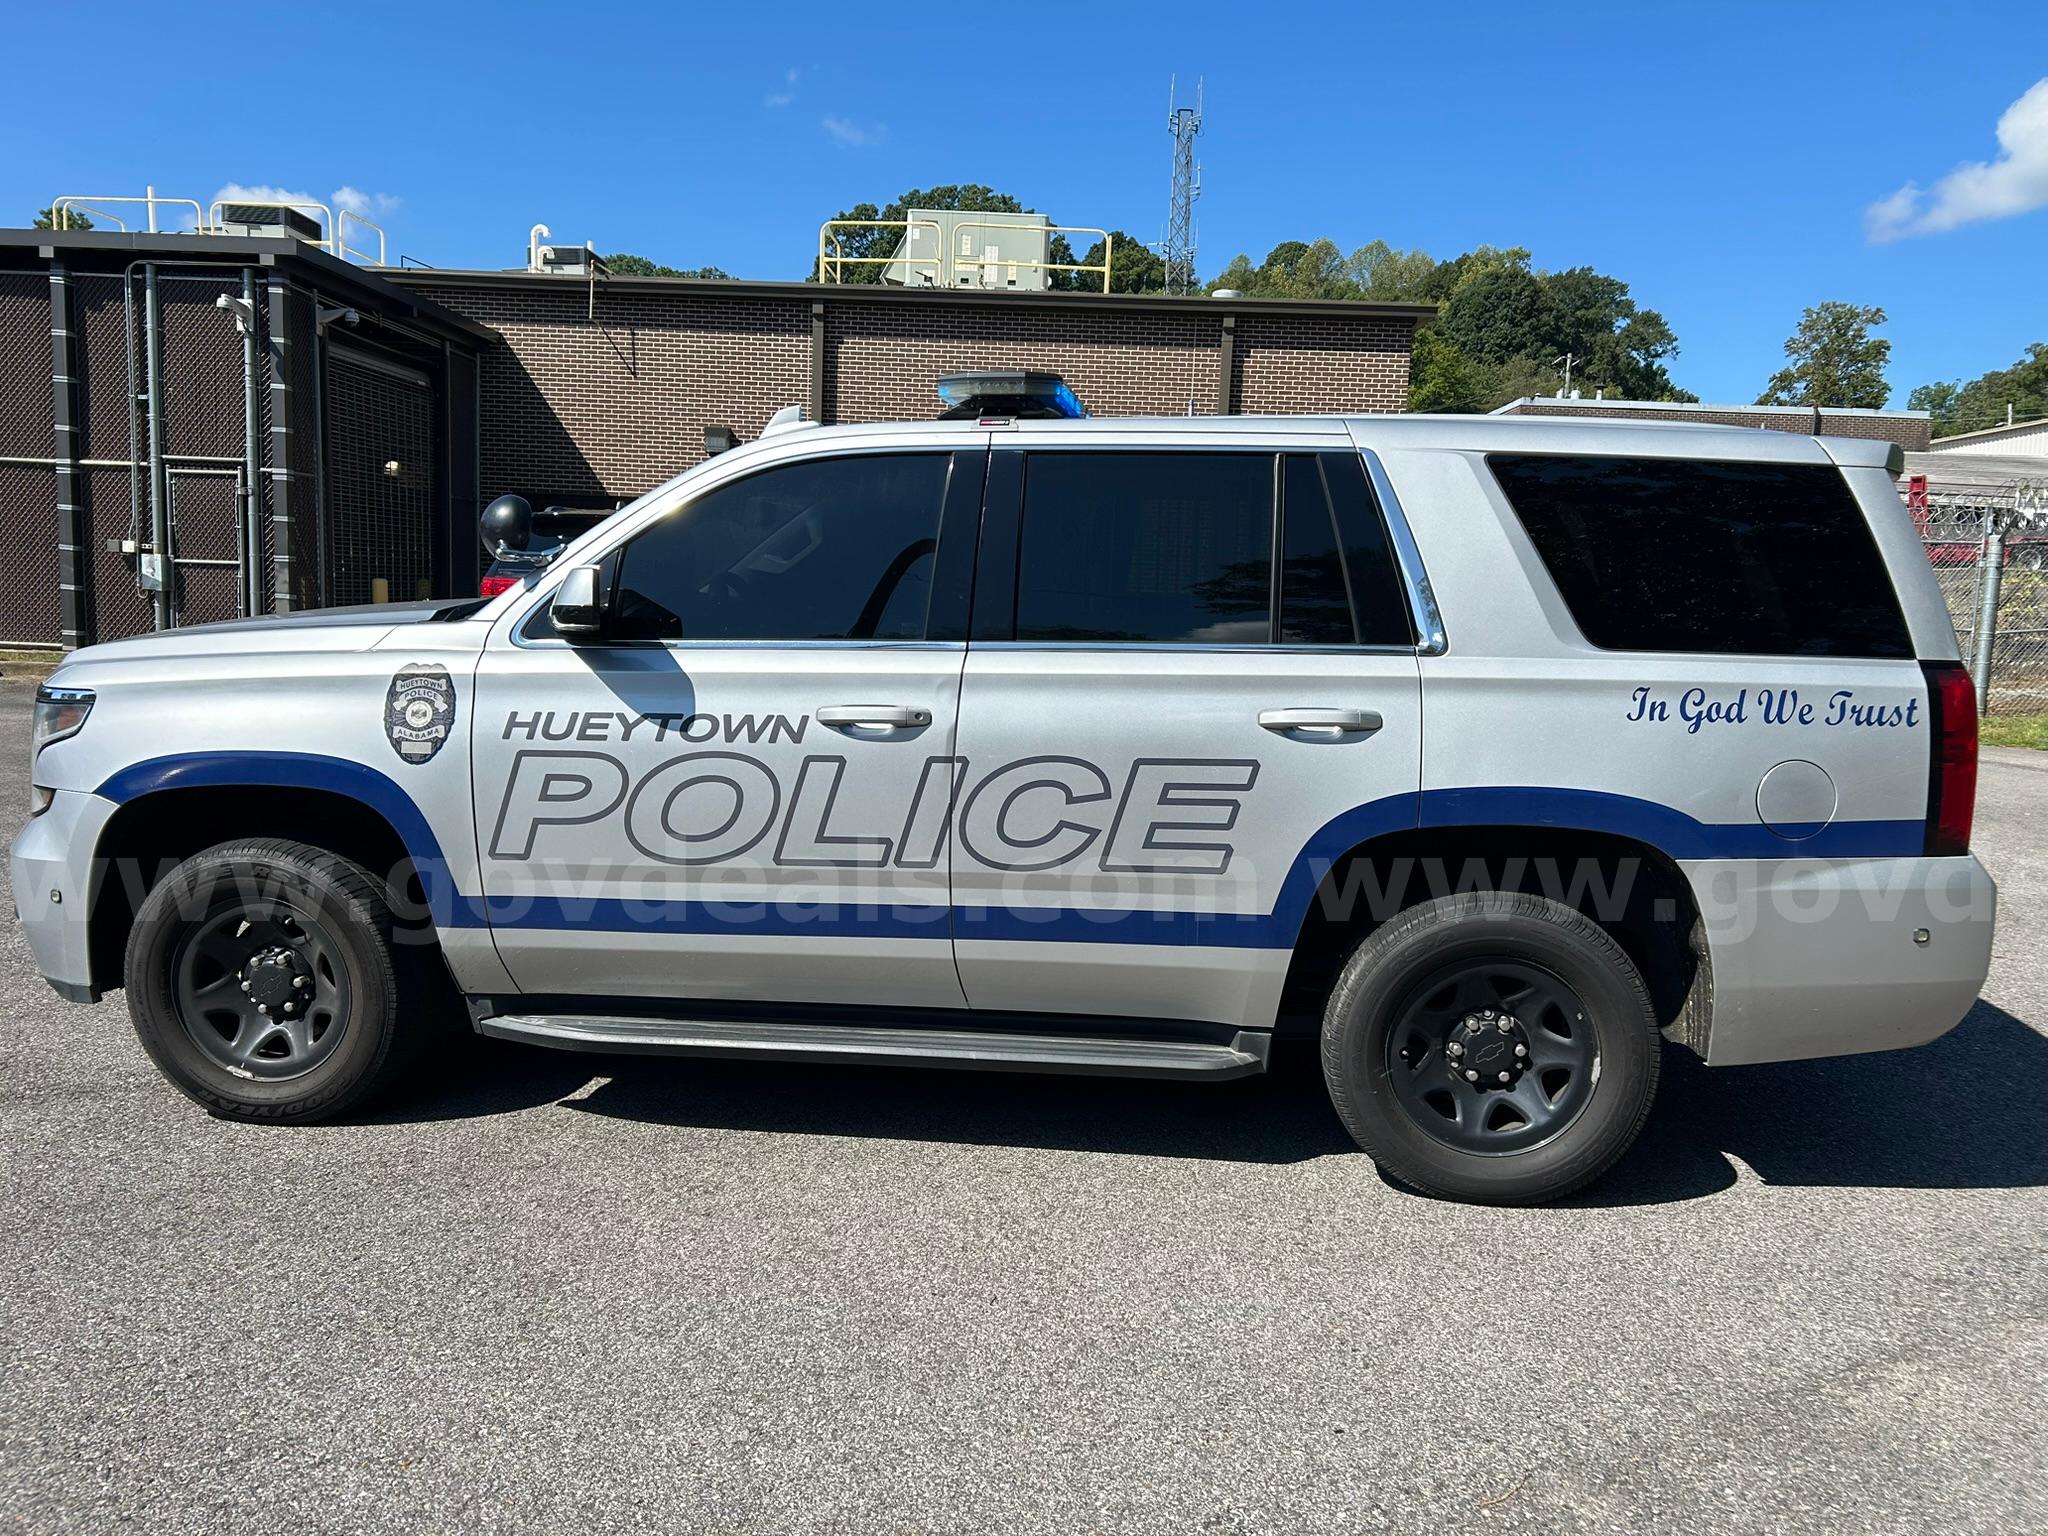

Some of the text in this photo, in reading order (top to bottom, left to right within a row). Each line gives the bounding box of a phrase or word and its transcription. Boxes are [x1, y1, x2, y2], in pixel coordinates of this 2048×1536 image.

[400, 679, 443, 690] HUEYTOWN
[404, 689, 438, 701] POLICE
[1626, 686, 1919, 734] In God We Trust
[397, 727, 440, 740] ALABAMA
[501, 711, 810, 744] HUEYTOWN
[488, 749, 1261, 875] POLICE
